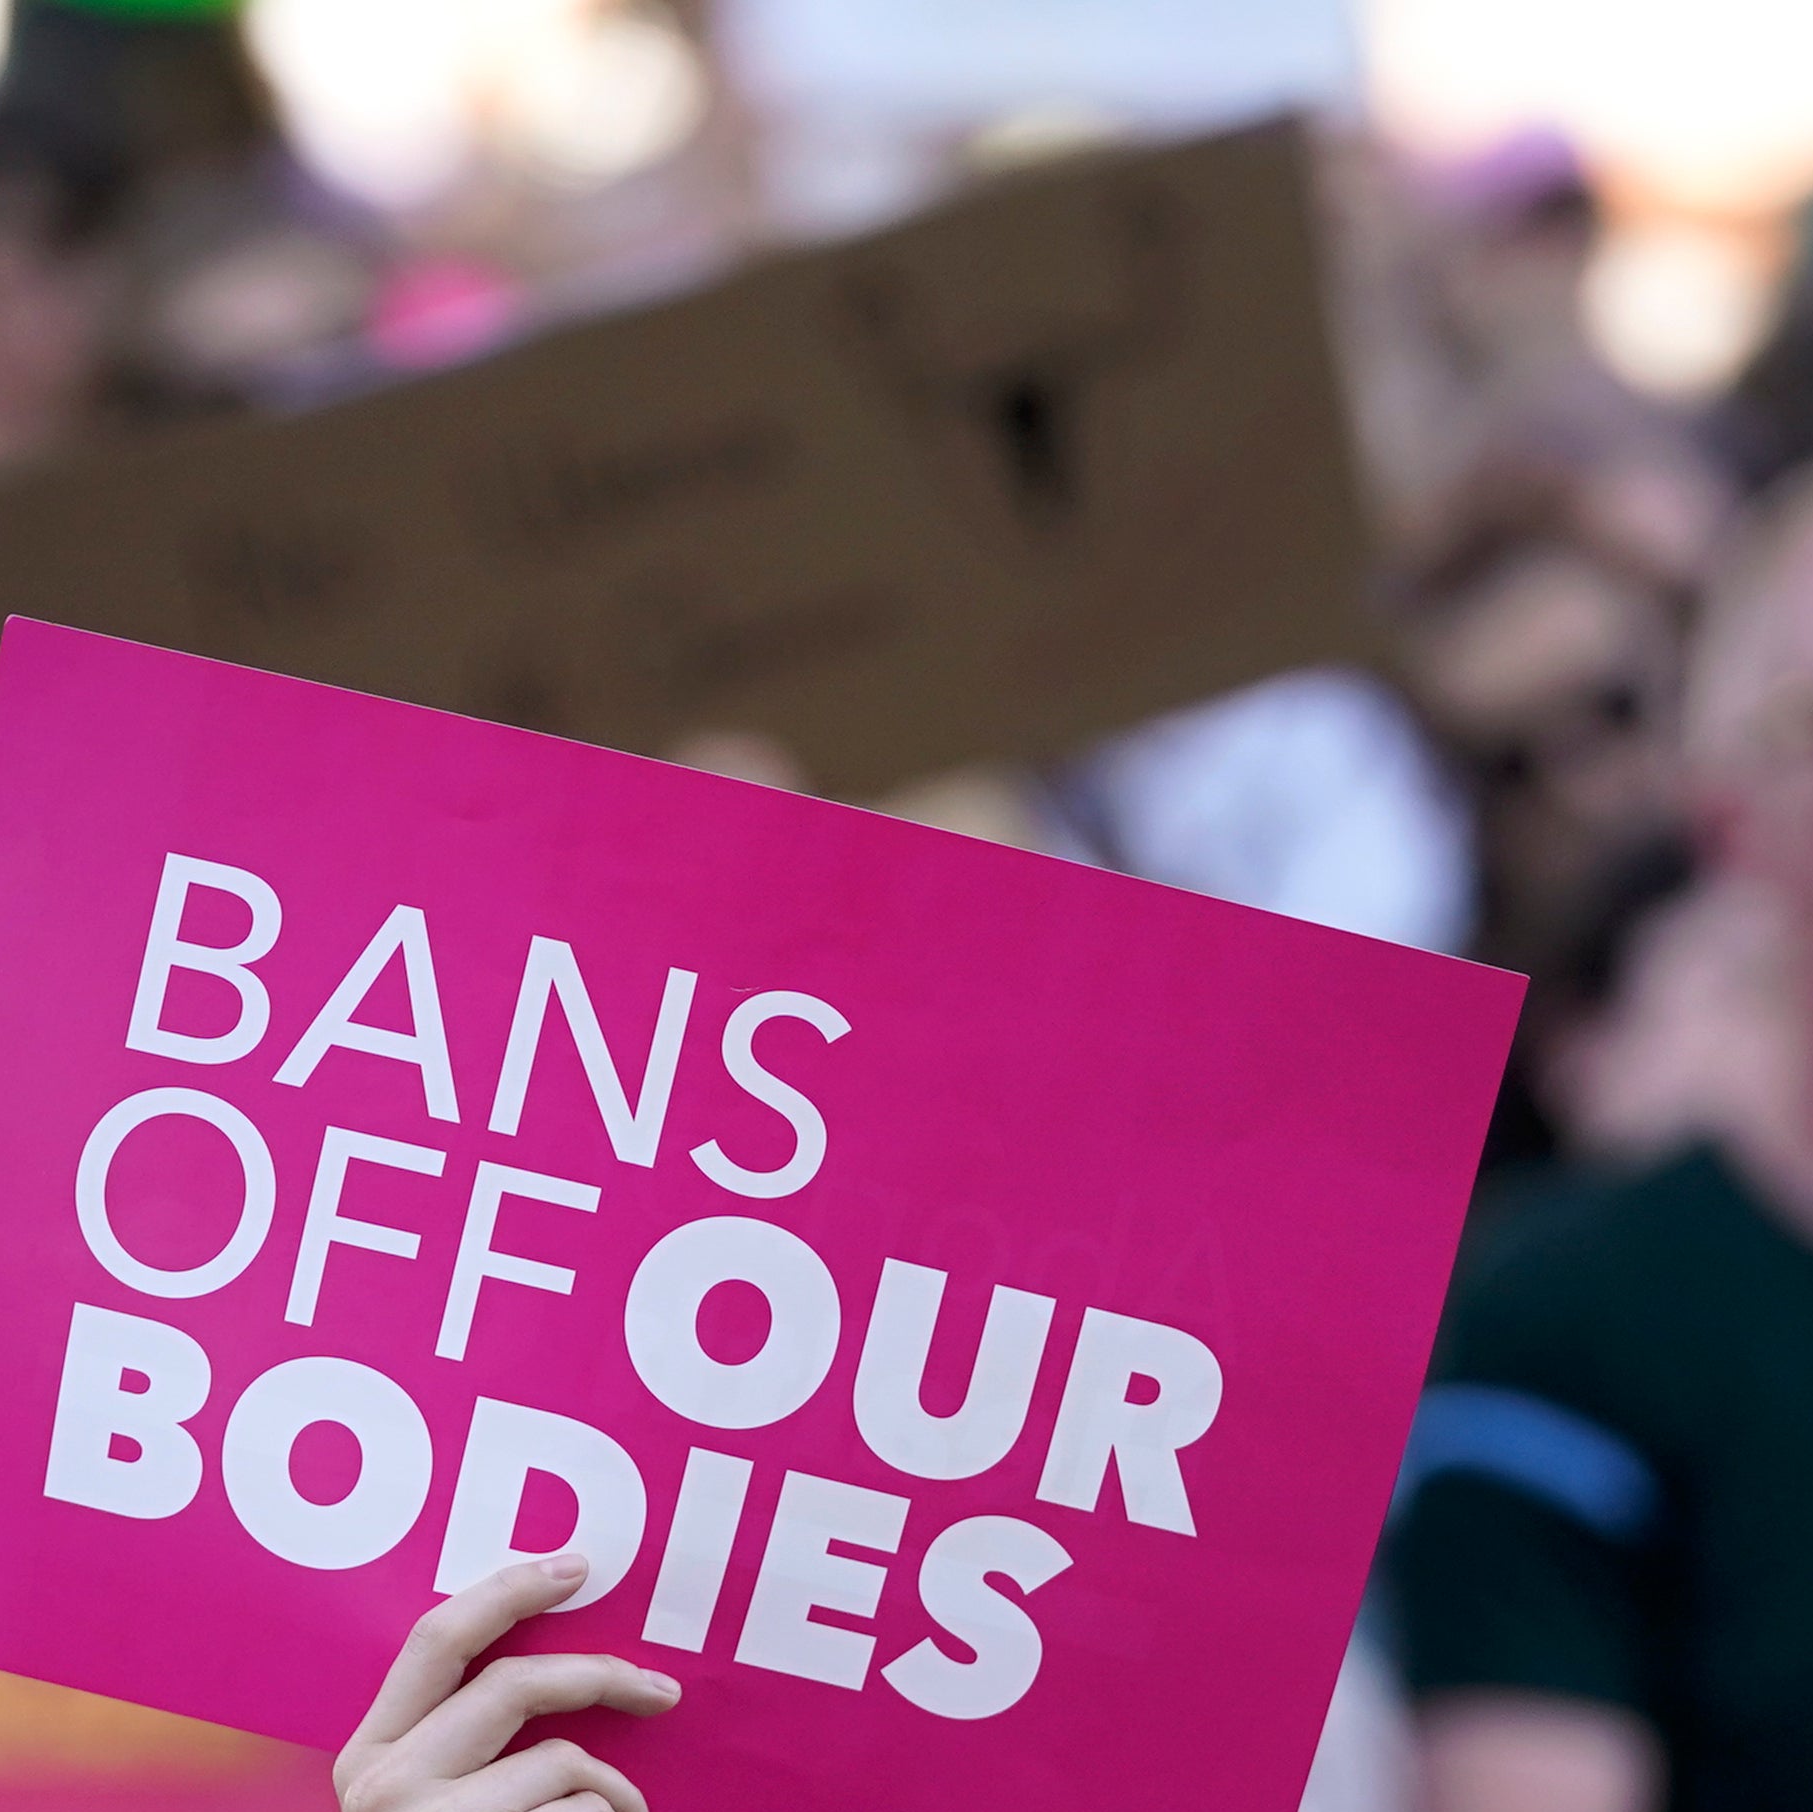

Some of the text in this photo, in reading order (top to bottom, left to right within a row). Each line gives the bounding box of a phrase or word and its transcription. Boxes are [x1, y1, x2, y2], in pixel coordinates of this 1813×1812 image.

[125, 852, 851, 1198] BANS
[44, 1302, 1073, 1719] BODIES
[76, 1087, 601, 1361] OFF
[625, 1216, 1222, 1536] OUR
